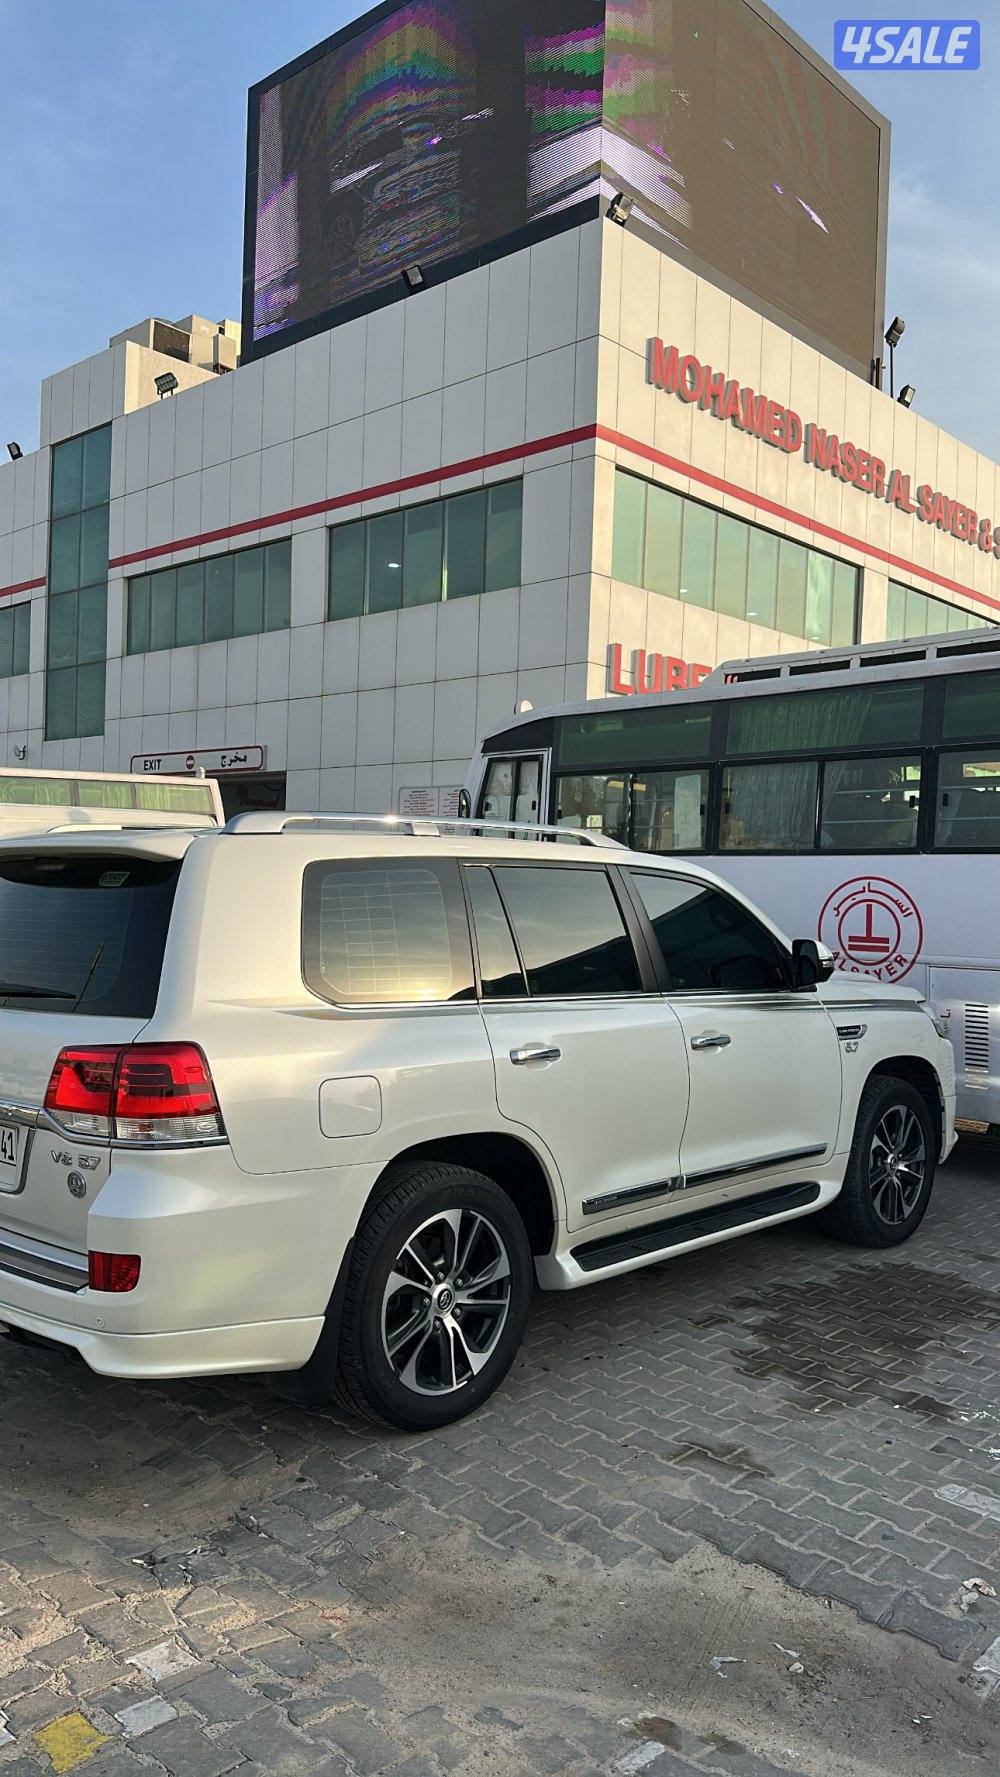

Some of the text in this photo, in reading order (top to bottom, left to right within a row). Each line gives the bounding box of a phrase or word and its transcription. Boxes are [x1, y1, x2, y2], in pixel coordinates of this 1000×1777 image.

[646, 337, 802, 453] MOHAMED
[803, 423, 886, 499] NASER
[885, 469, 916, 514] AL
[916, 485, 978, 545] SAYER
[978, 518, 992, 553] &
[143, 758, 162, 771] EXIT
[220, 751, 248, 767] مخرج
[50, 1150, 73, 1166] V8
